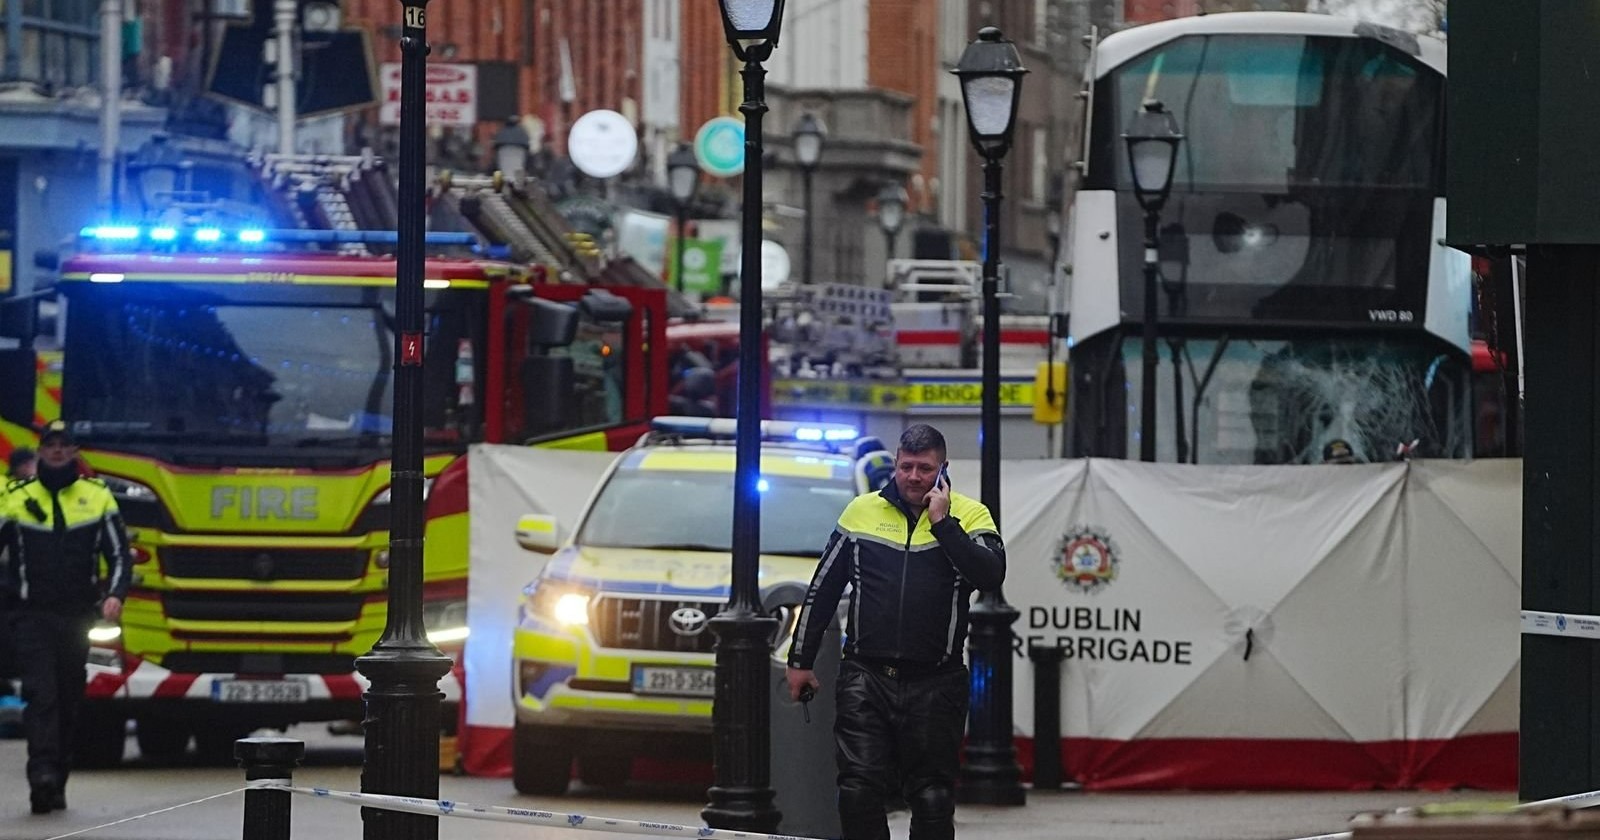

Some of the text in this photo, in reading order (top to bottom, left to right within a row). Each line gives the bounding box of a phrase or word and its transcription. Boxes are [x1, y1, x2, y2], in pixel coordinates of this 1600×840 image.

[408, 8, 426, 26] 16
[1368, 309, 1397, 322] VWD
[921, 384, 1022, 404] BRIGDE
[211, 485, 320, 520] FIRE
[1029, 606, 1140, 632] DUBLIN
[1056, 636, 1193, 665] BRIGADE
